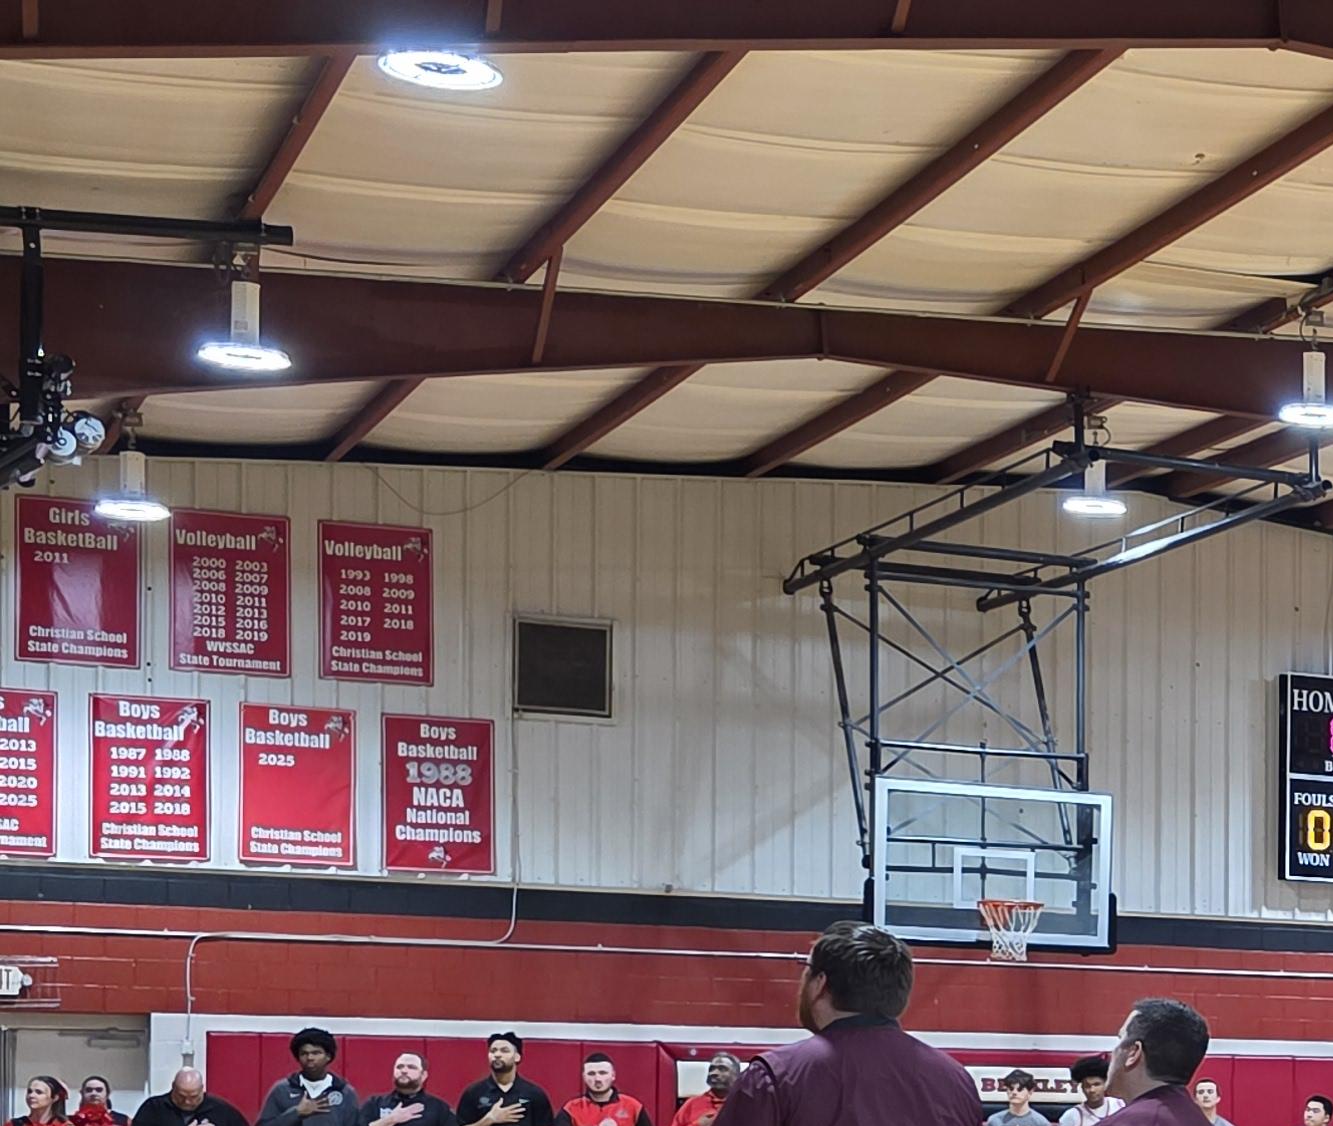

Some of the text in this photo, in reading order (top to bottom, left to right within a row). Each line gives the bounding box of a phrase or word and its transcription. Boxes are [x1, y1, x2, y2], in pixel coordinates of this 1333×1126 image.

[49, 507, 91, 526] Girls
[176, 529, 256, 551] Volleyball
[34, 550, 69, 564] 2011
[324, 540, 402, 561] Volleyball
[235, 571, 268, 584] 2007
[235, 583, 268, 596] 2009
[382, 588, 415, 600] 2009
[193, 592, 267, 607] 2010 2011
[340, 599, 413, 615] 2010 2011
[193, 604, 268, 619] 2012 2013
[193, 615, 268, 630] 2015 2016
[340, 615, 414, 630] 2017 2018
[29, 625, 127, 644] Christian School
[193, 626, 268, 641] 2018 2019
[340, 630, 371, 642] 2019
[28, 640, 128, 659] State Champions
[206, 640, 255, 655] WVSSAC
[332, 646, 422, 662] Christian School
[179, 653, 281, 671] State Tournament
[331, 660, 423, 677] State Champions
[119, 700, 160, 719] Boys
[268, 708, 308, 727] Boys
[94, 721, 185, 741] Basketball
[245, 728, 330, 749] Basketball
[420, 723, 456, 740] Boys
[110, 746, 146, 760] 1987
[397, 742, 478, 761] Basketball
[258, 753, 295, 767] 2025
[110, 765, 191, 780] 1991 1992
[406, 761, 473, 785] 1988
[109, 783, 191, 797] 2013 2014
[412, 786, 465, 807] NACA
[109, 801, 191, 815] 2015 2018
[406, 808, 470, 825] National
[102, 822, 199, 837] Christian School
[251, 826, 342, 843] Christian School
[395, 825, 482, 844] Champions
[101, 837, 200, 853] State Champions
[250, 841, 343, 858] State Champions
[1297, 852, 1331, 867] WON
